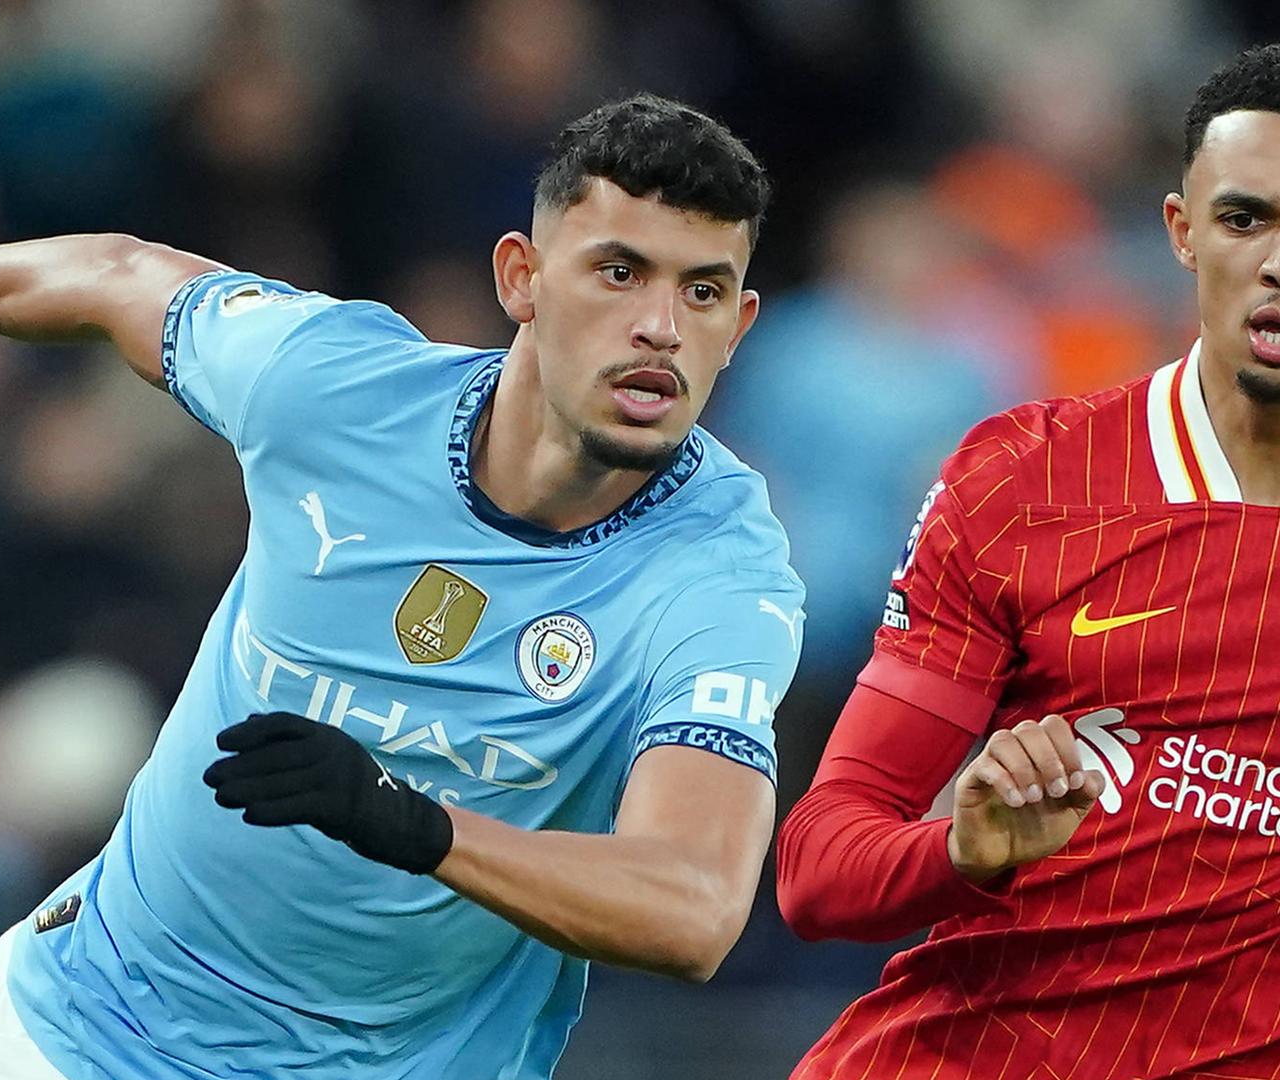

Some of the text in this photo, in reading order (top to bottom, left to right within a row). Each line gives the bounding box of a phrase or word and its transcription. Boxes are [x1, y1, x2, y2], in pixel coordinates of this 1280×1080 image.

[410, 625, 443, 651] FIFA
[532, 618, 592, 660] MANCHESTER
[232, 614, 558, 790] ETIHAD
[535, 682, 555, 697] CITY
